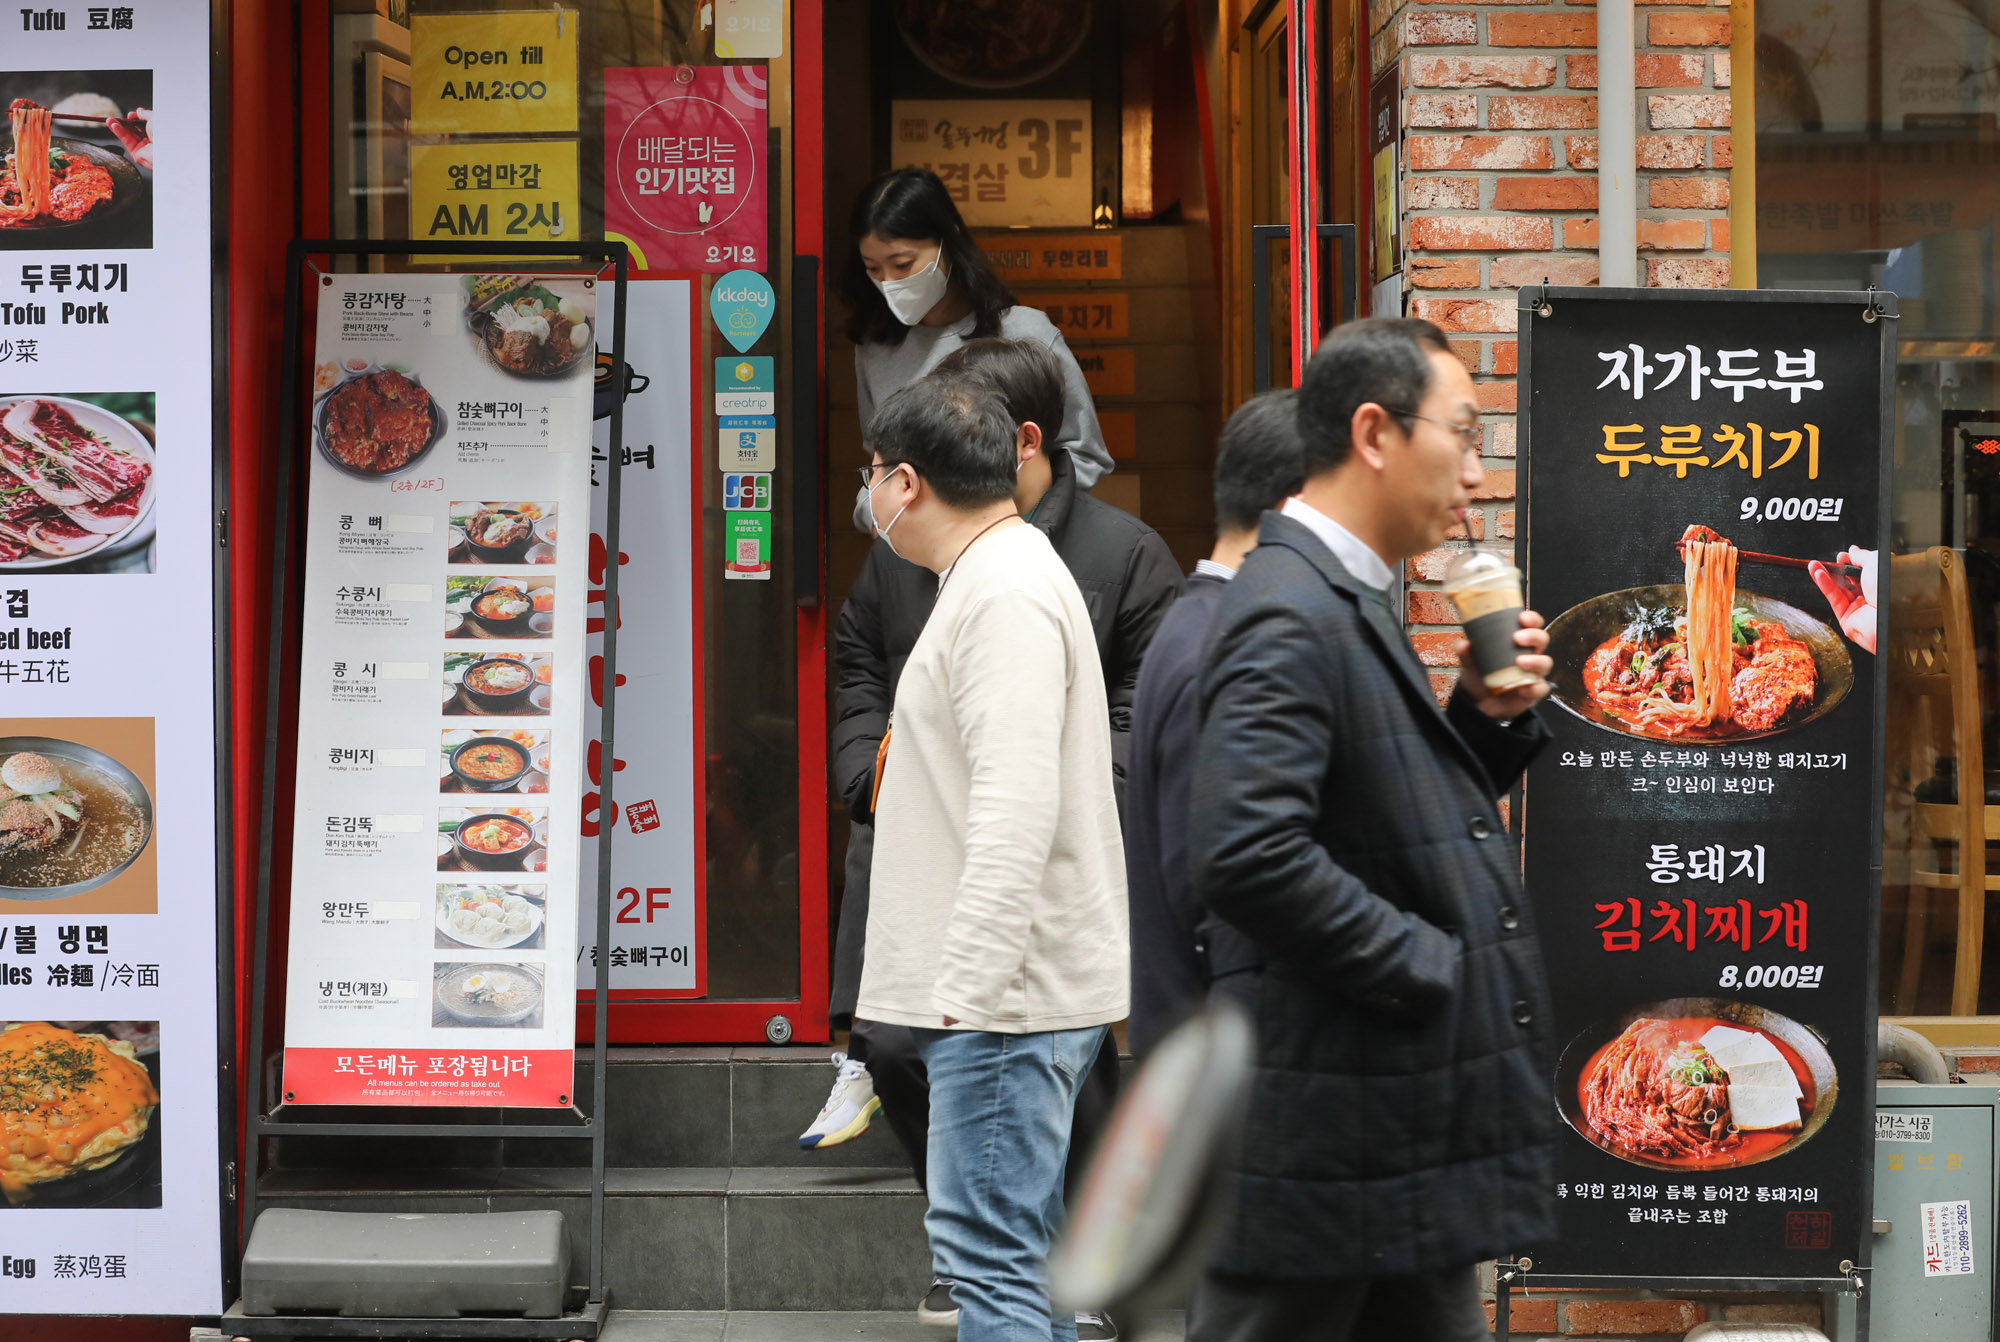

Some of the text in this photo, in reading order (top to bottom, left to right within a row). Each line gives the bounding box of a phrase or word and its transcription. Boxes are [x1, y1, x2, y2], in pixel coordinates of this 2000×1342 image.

[20, 8, 134, 31] Tufu 豆腐
[724, 16, 774, 33] 요기요
[445, 46, 544, 69] Open till
[441, 80, 547, 101] A.M.2:00
[637, 136, 737, 164] 배달되는
[1017, 118, 1083, 179] 3F
[447, 163, 542, 190] 영업마감
[635, 167, 735, 195] 인기맛집
[904, 162, 1009, 202] 겹살
[428, 202, 563, 236] AM 2시
[1756, 202, 1841, 231] 한족발
[705, 245, 757, 263] 요기요
[20, 263, 129, 293] 두루치기
[342, 292, 407, 310] 콩감자탕
[717, 287, 769, 308] kkday
[1, 302, 109, 325] Tofu Pork
[1078, 355, 1105, 371] ork
[1596, 343, 1824, 403] 자가두부
[457, 401, 522, 419] 참숯뼈구이
[722, 397, 767, 410] creatrip
[541, 429, 549, 437] 小
[458, 442, 488, 451] 치즈추가
[1595, 422, 1820, 480] 두루치기
[726, 485, 768, 498] JCB
[1740, 496, 1843, 523] 9,000원
[0, 589, 29, 618] 겹
[336, 586, 381, 601] 수콩시
[27, 628, 71, 650] beef
[0, 659, 70, 683] 牛五花
[329, 748, 374, 764] 콩비지
[1560, 751, 1848, 770] 오늘 만든 손두부와 넉넉한 돼지고기
[1631, 776, 1775, 795] 크~ 인심이 보인다
[325, 816, 373, 833] 돈김뚝
[1645, 843, 1766, 885] 통돼지
[322, 902, 369, 918] 왕만두
[616, 887, 671, 923] 2F
[1594, 896, 1808, 952] 김치찌개
[58, 925, 109, 954] 냉면
[0, 963, 33, 985] les
[1718, 965, 1824, 991] 8,000원
[333, 1055, 533, 1078] 모든메뉴 포장됩니다
[1908, 1117, 1931, 1131] 시공
[1574, 1183, 1605, 1199] 익힌
[1611, 1184, 1658, 1201] 김치와
[1665, 1185, 1697, 1201] 듬뿍
[1702, 1185, 1751, 1202] 들어간
[1755, 1186, 1819, 1203] 통돼지의
[1627, 1206, 1728, 1224] 끝내주는 조합
[1957, 1204, 1971, 1272] 010-2899-5262
[3, 1254, 127, 1279] Egg 蒸鸡蛋
[1926, 1243, 1942, 1273] 카드
